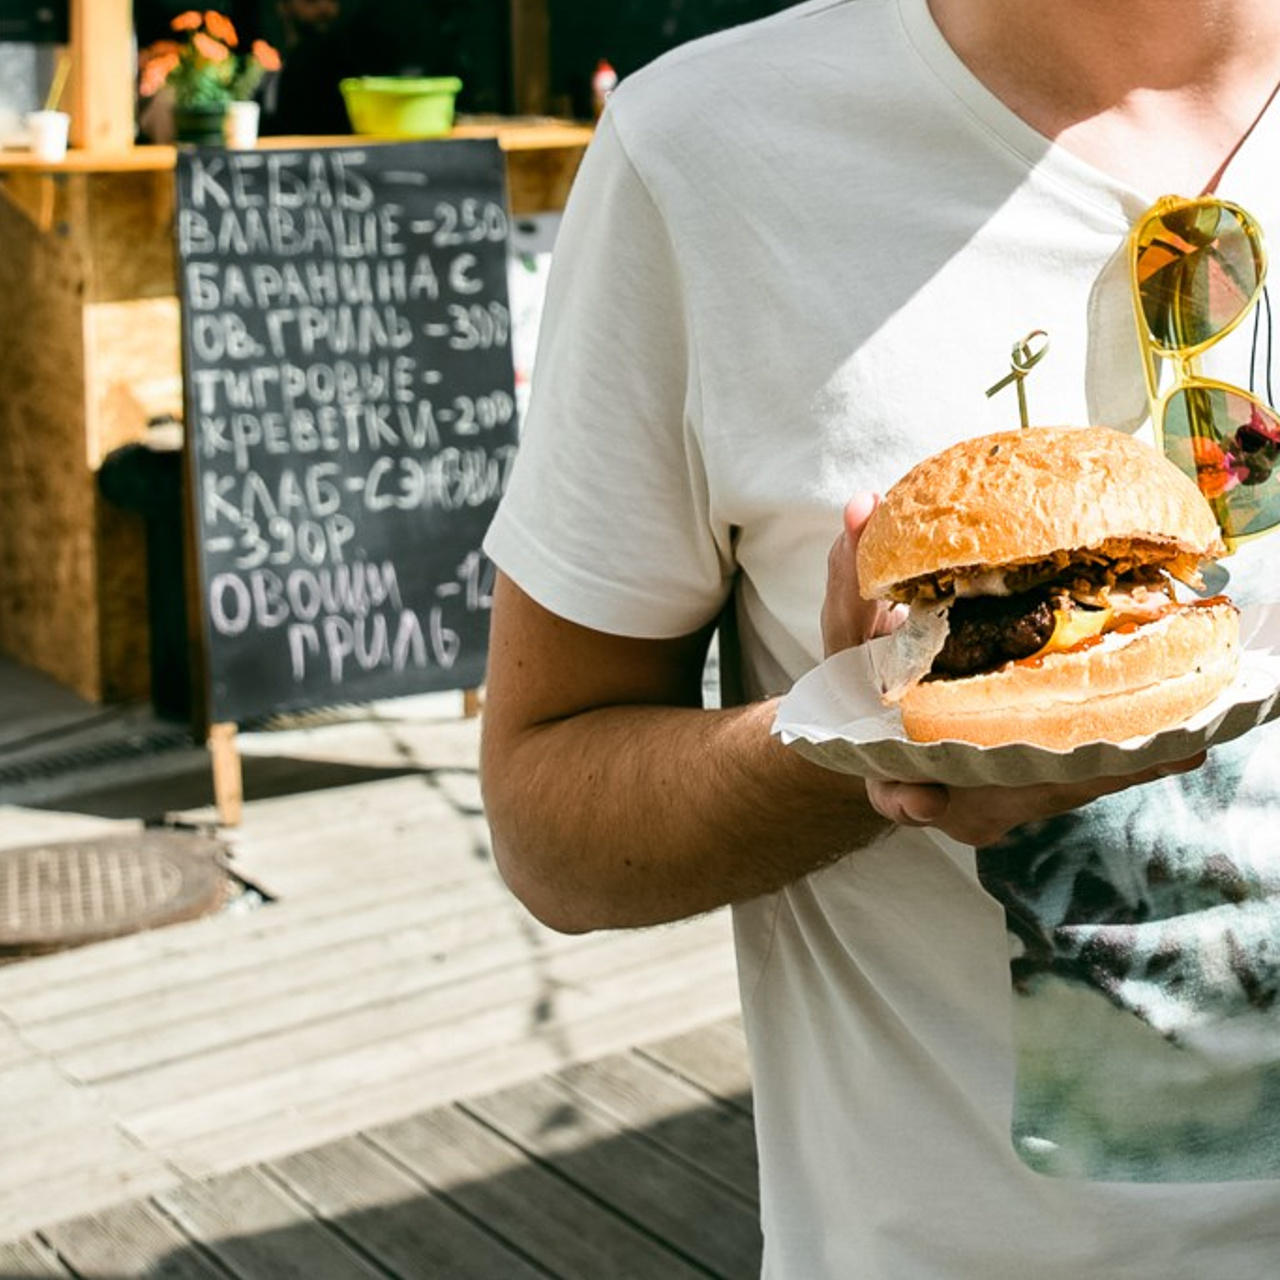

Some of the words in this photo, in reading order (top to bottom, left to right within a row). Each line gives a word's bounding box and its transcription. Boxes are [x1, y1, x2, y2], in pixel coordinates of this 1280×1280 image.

[192, 151, 374, 211] КЕБАБ
[187, 254, 440, 309] БАРАНИНА
[450, 253, 484, 294] С
[266, 304, 413, 358] ГРИЛЬ
[201, 400, 441, 470] КРЕВЕТКИ
[210, 560, 402, 636] ОВОЩИ
[288, 607, 461, 684] ГРИЛЬ
